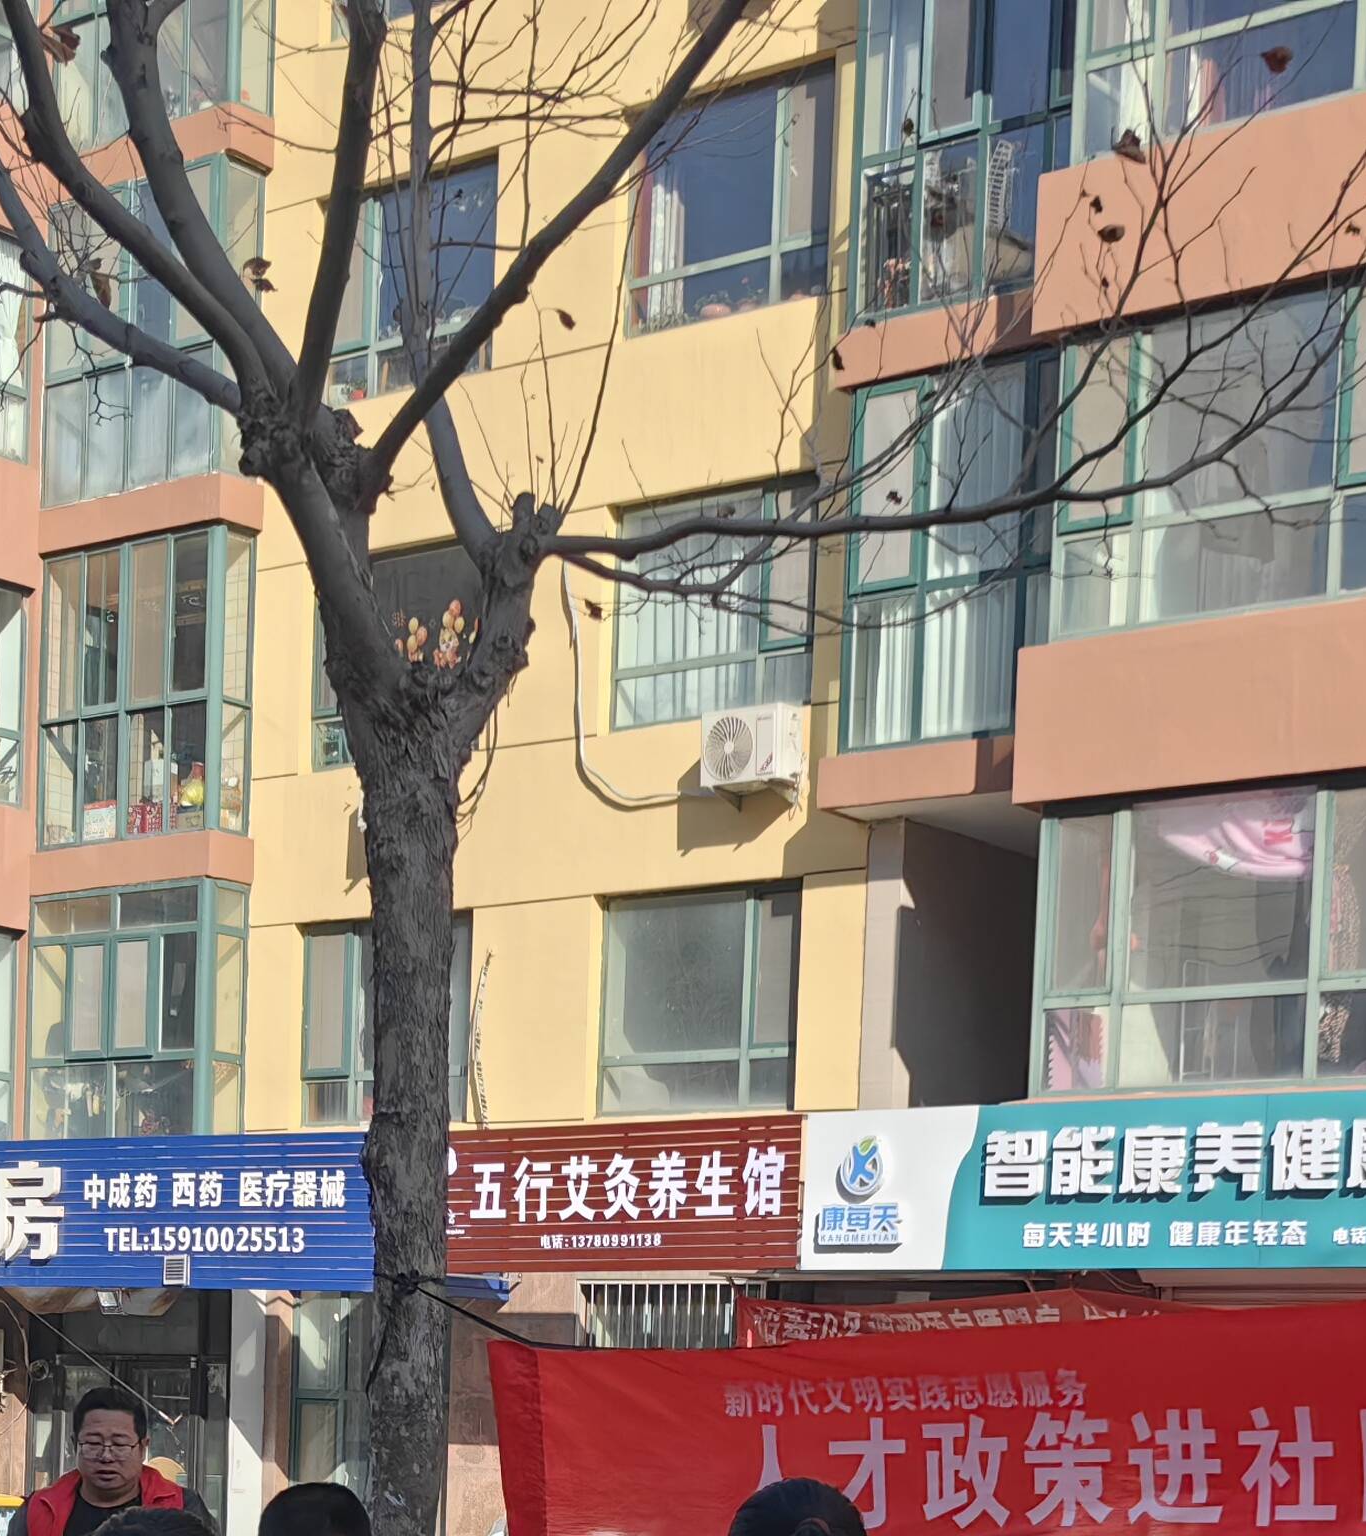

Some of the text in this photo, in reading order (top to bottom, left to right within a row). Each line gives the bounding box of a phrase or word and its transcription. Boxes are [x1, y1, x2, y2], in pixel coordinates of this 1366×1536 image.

[84, 1169, 346, 1209] 中成药 西药 医疗器械
[469, 1145, 785, 1223] 五行艾灸养生馆
[821, 1204, 900, 1231] 康每天
[104, 1226, 305, 1253] TEL:15910025513
[820, 1232, 899, 1243] KANGMEITIAN
[1022, 1221, 1151, 1249] 每天半小时
[1169, 1219, 1308, 1248] 健康年轻态
[723, 1368, 1087, 1419] 新时代文明实践志愿服务
